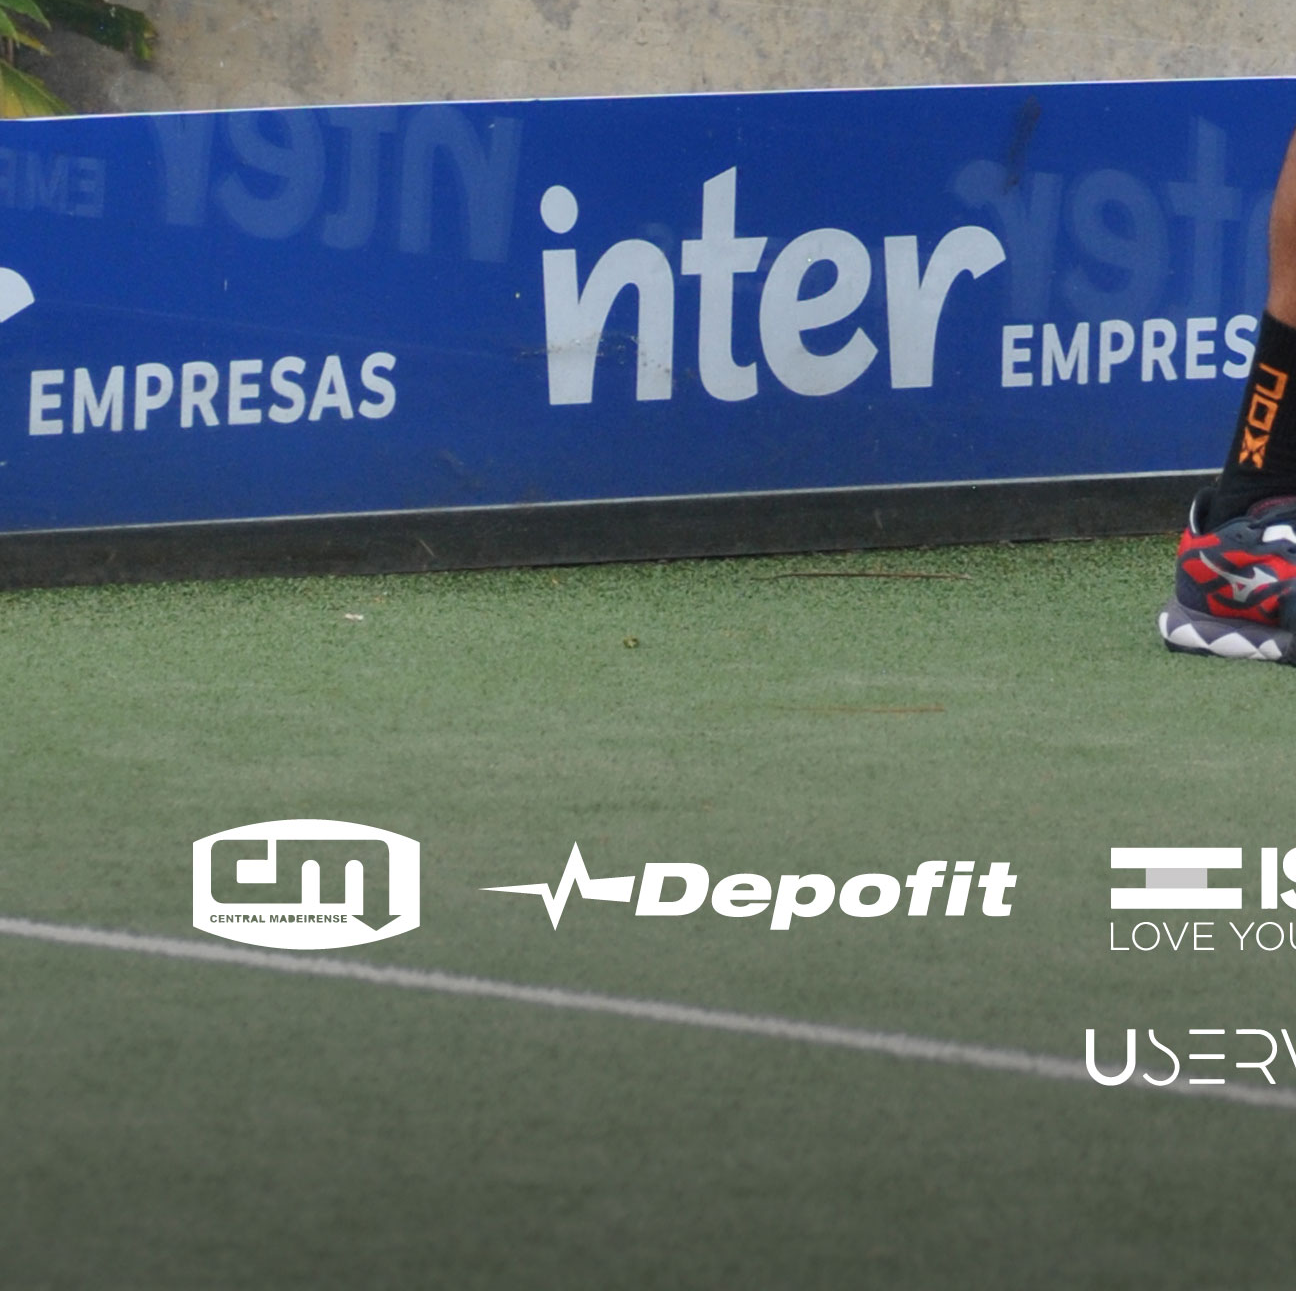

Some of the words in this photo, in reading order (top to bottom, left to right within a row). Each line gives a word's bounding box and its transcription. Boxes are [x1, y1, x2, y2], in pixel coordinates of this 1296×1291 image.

[540, 166, 1006, 405] inter
[1001, 314, 1258, 388] EMPRES
[28, 351, 396, 436] EMPRESAS
